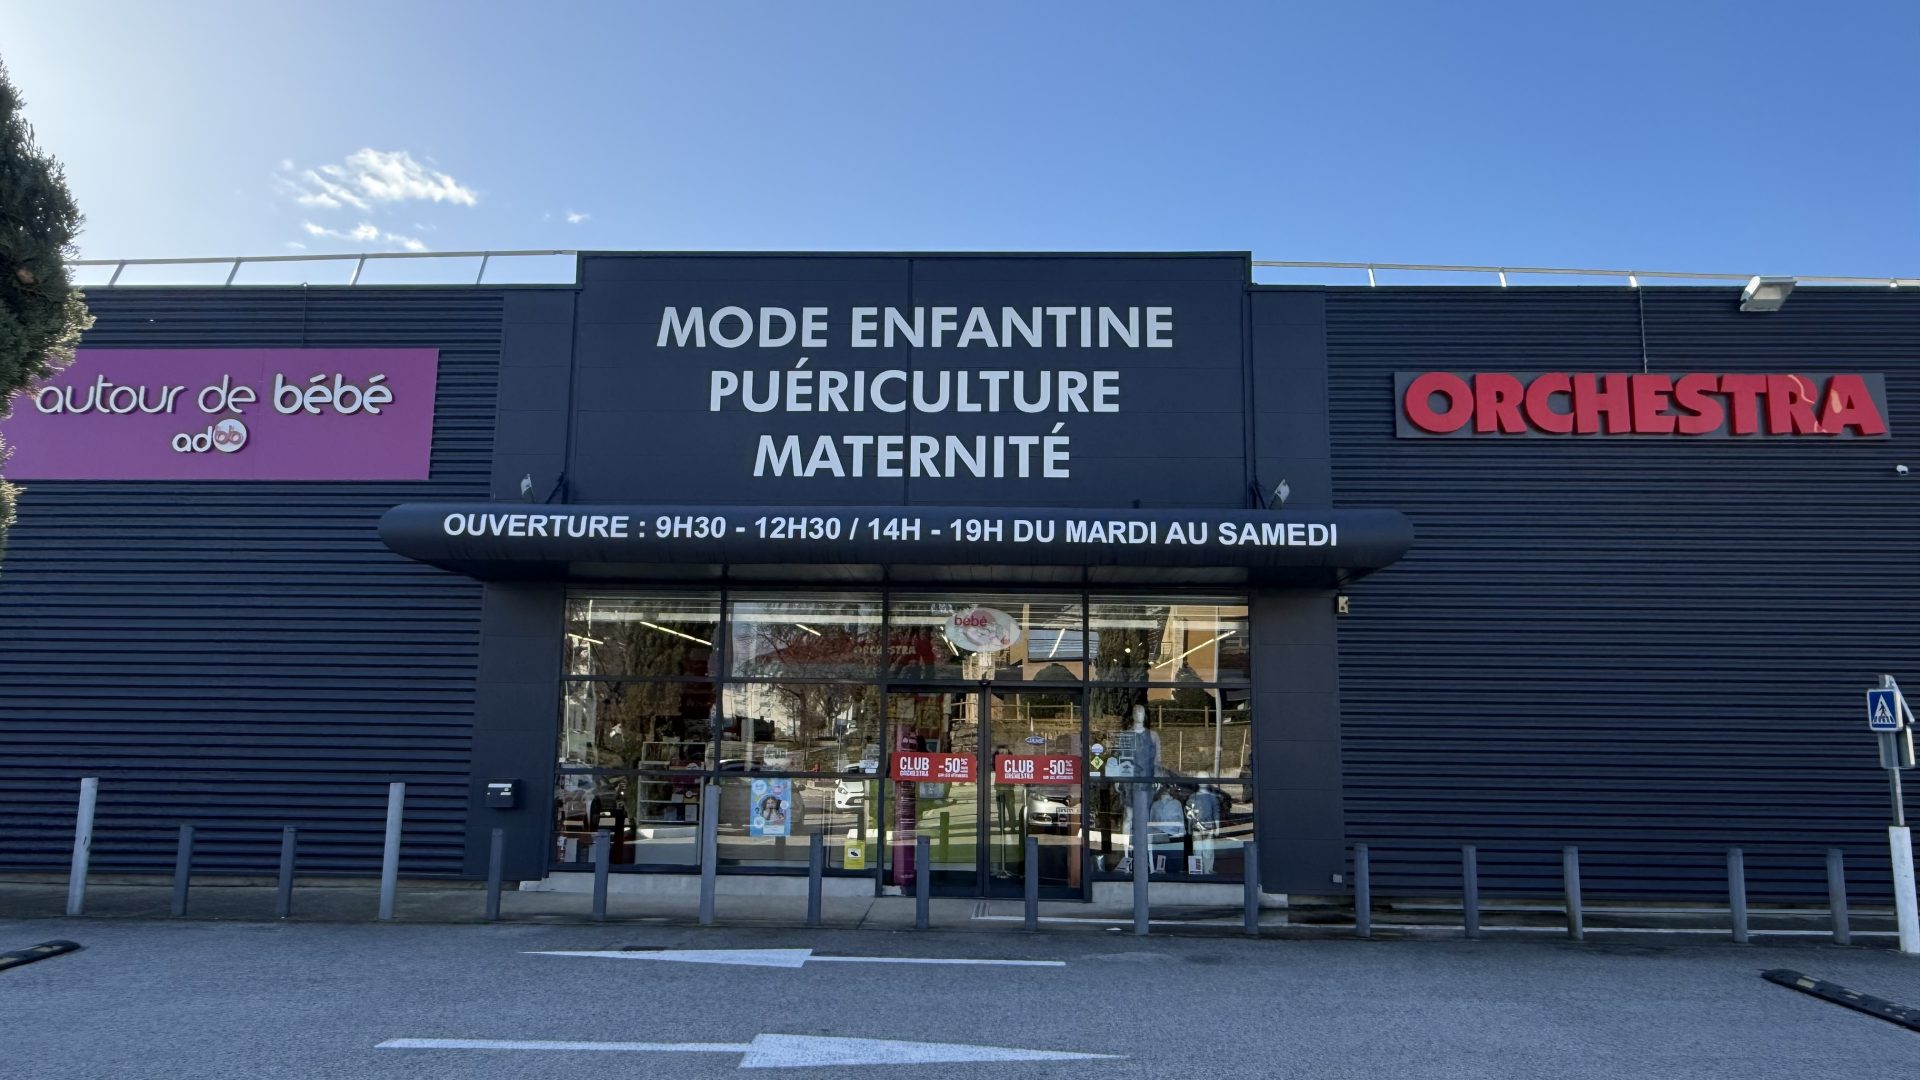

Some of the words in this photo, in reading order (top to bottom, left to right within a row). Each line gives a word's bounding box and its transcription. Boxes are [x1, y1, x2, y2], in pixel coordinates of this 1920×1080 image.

[656, 306, 828, 348] MODE
[851, 306, 1173, 348] ENFANTINE
[35, 374, 189, 414] autour
[198, 374, 256, 414] de
[272, 373, 393, 414] bébé
[709, 357, 1120, 413] PUÉRICULTURE
[1405, 371, 1886, 435] ORCHESTRA
[753, 422, 1070, 478] MATERNITÉ
[443, 513, 629, 538] OUVERTURE
[655, 515, 727, 538] 9H30
[754, 516, 841, 540] 12H30
[868, 517, 921, 541] 14H
[950, 518, 1003, 542] 19H
[1013, 519, 1055, 542] DU
[1065, 520, 1157, 544] MARDI
[1164, 521, 1208, 545] AU
[1218, 522, 1337, 547] SAMEDI
[899, 756, 930, 770] CLUB
[1004, 759, 1034, 773] CLUB
